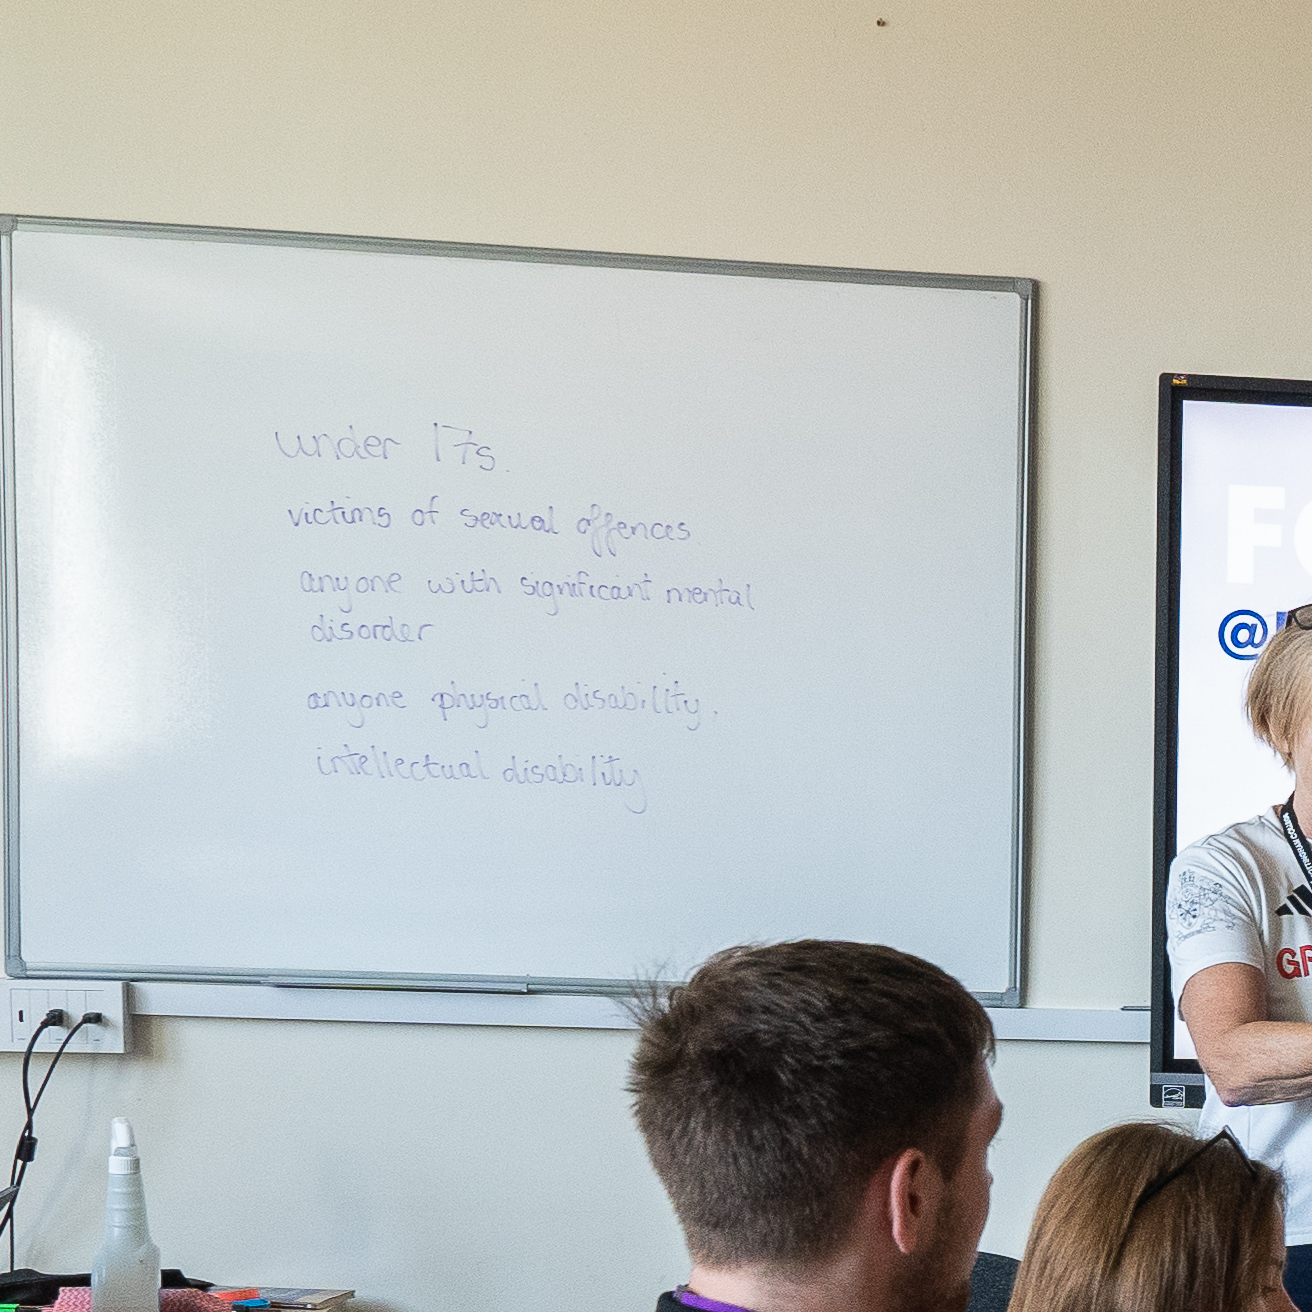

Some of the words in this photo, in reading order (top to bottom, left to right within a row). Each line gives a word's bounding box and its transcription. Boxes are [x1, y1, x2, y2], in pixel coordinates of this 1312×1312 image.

[275, 425, 402, 461] under
[287, 495, 391, 529] victims
[411, 495, 440, 527] of
[460, 506, 559, 535] sexual
[300, 569, 402, 613] anyone
[428, 570, 501, 596] with
[520, 572, 653, 616] significant
[666, 582, 755, 611] mental
[311, 617, 435, 643] disorder
[306, 687, 407, 728] anyone
[430, 680, 548, 728] physical
[317, 743, 490, 783] intellectual
[503, 754, 647, 814] disability
